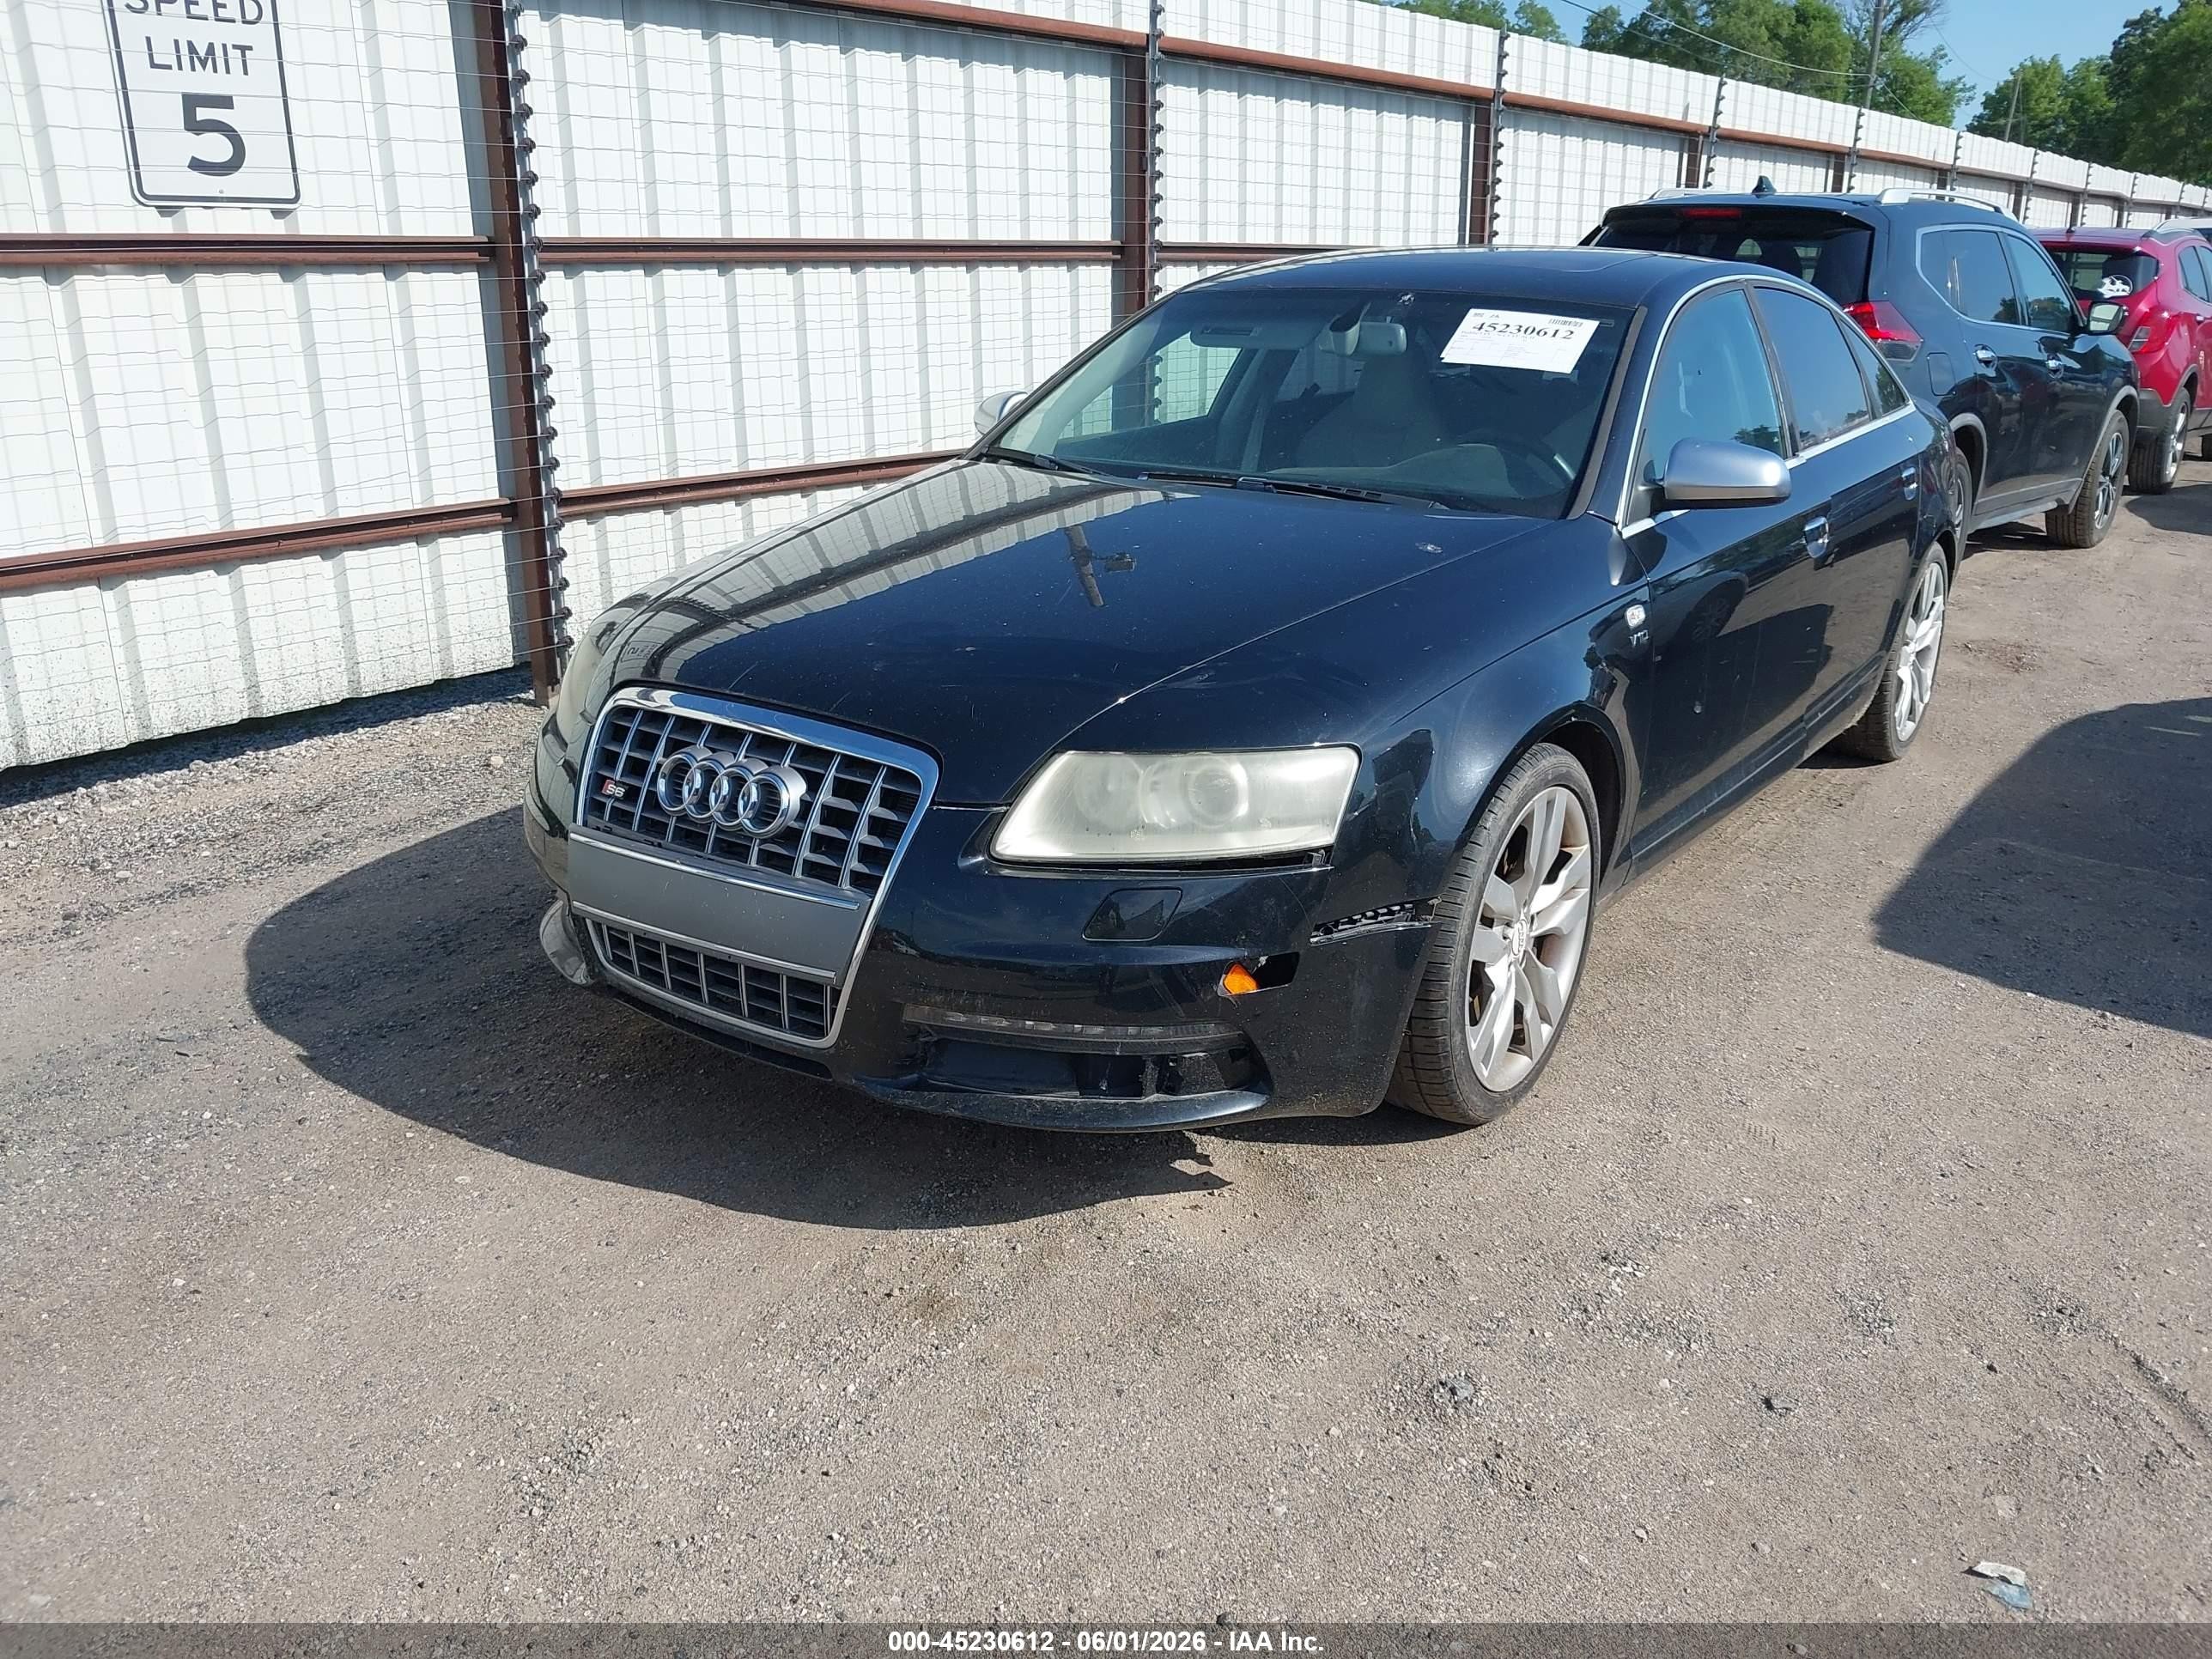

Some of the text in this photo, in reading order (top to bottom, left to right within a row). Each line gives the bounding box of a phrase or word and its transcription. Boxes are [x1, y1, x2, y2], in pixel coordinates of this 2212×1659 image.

[145, 36, 253, 76] LIMIT
[181, 93, 246, 177] 5
[1473, 322, 1575, 340] 45230612
[606, 783, 625, 798] S6
